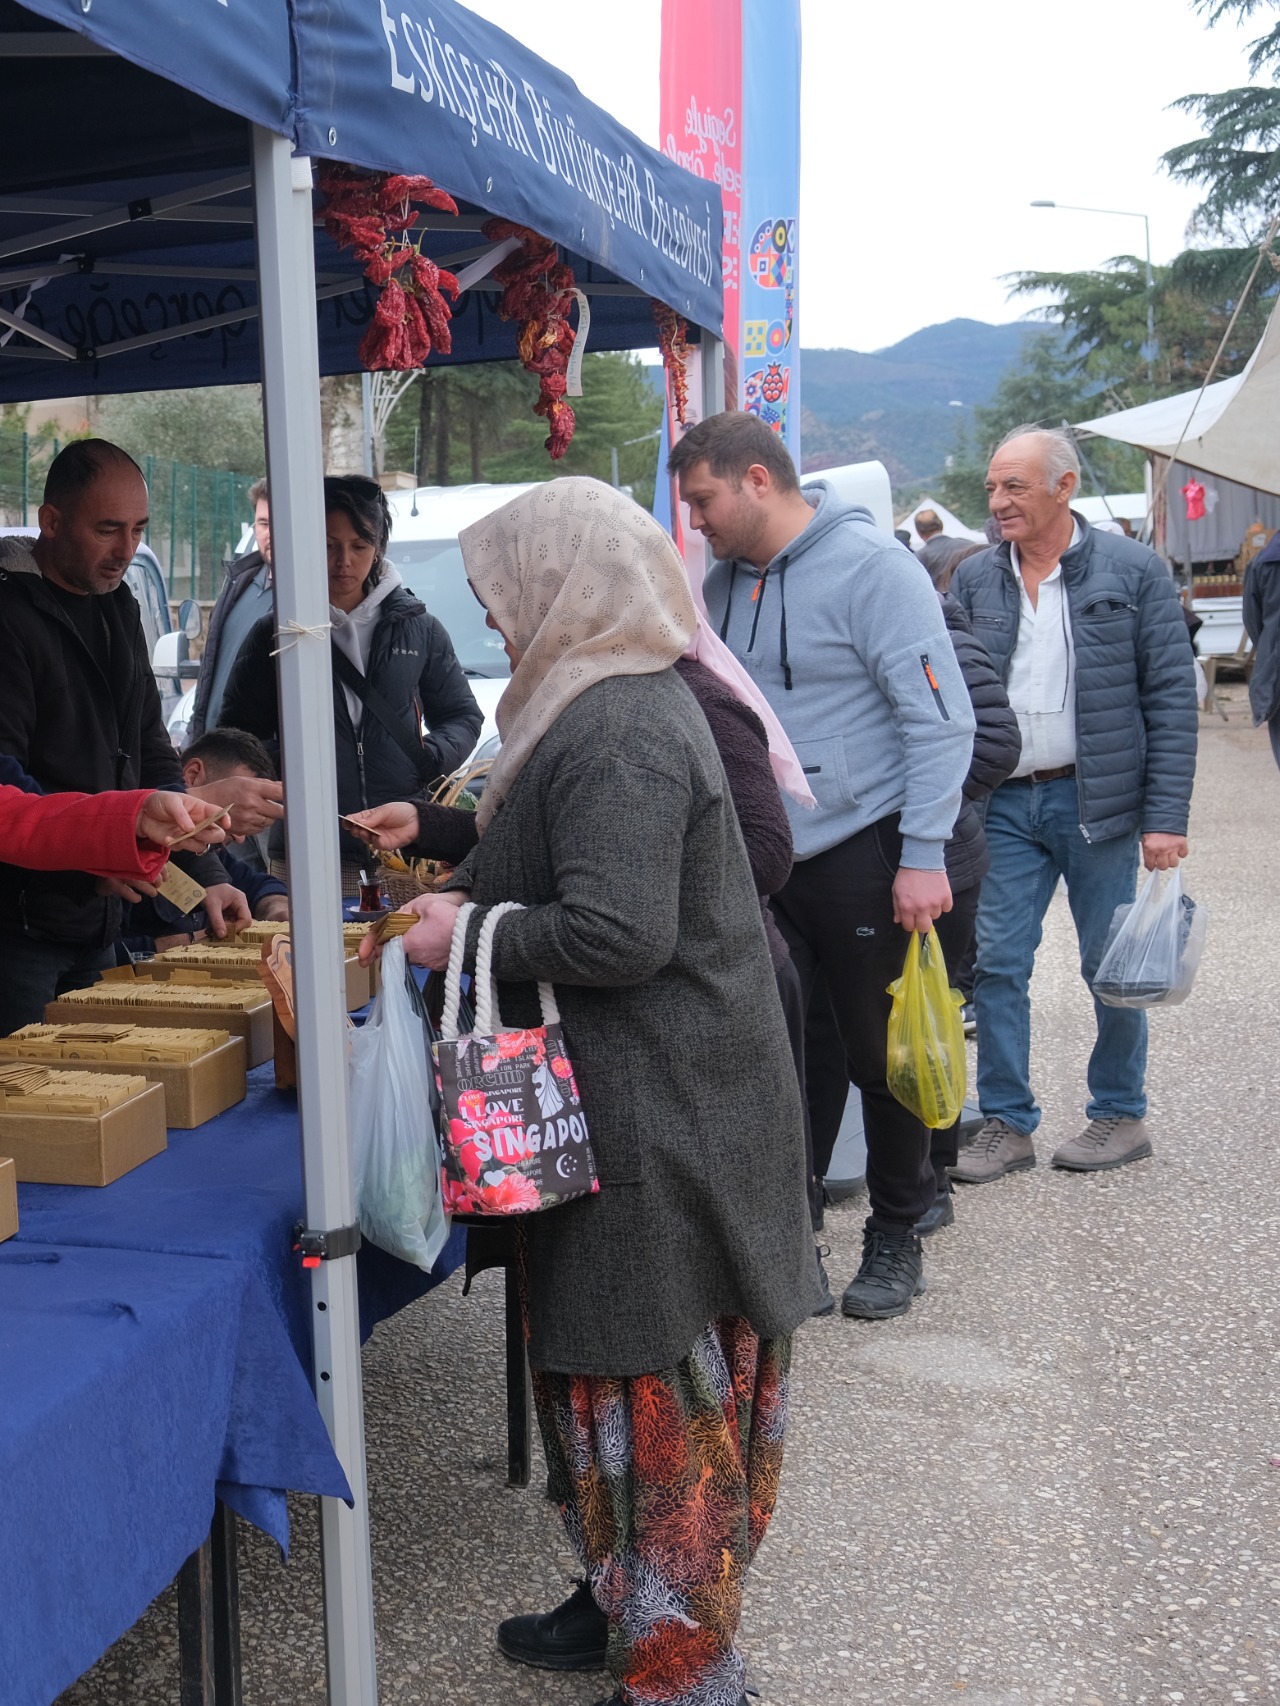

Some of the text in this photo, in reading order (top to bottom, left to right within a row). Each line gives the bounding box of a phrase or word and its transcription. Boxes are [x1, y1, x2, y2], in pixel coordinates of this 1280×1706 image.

[643, 168, 713, 288] BELEDİYESİ
[460, 1098, 525, 1120] I LOVE
[463, 1113, 525, 1129] SINGAPORE
